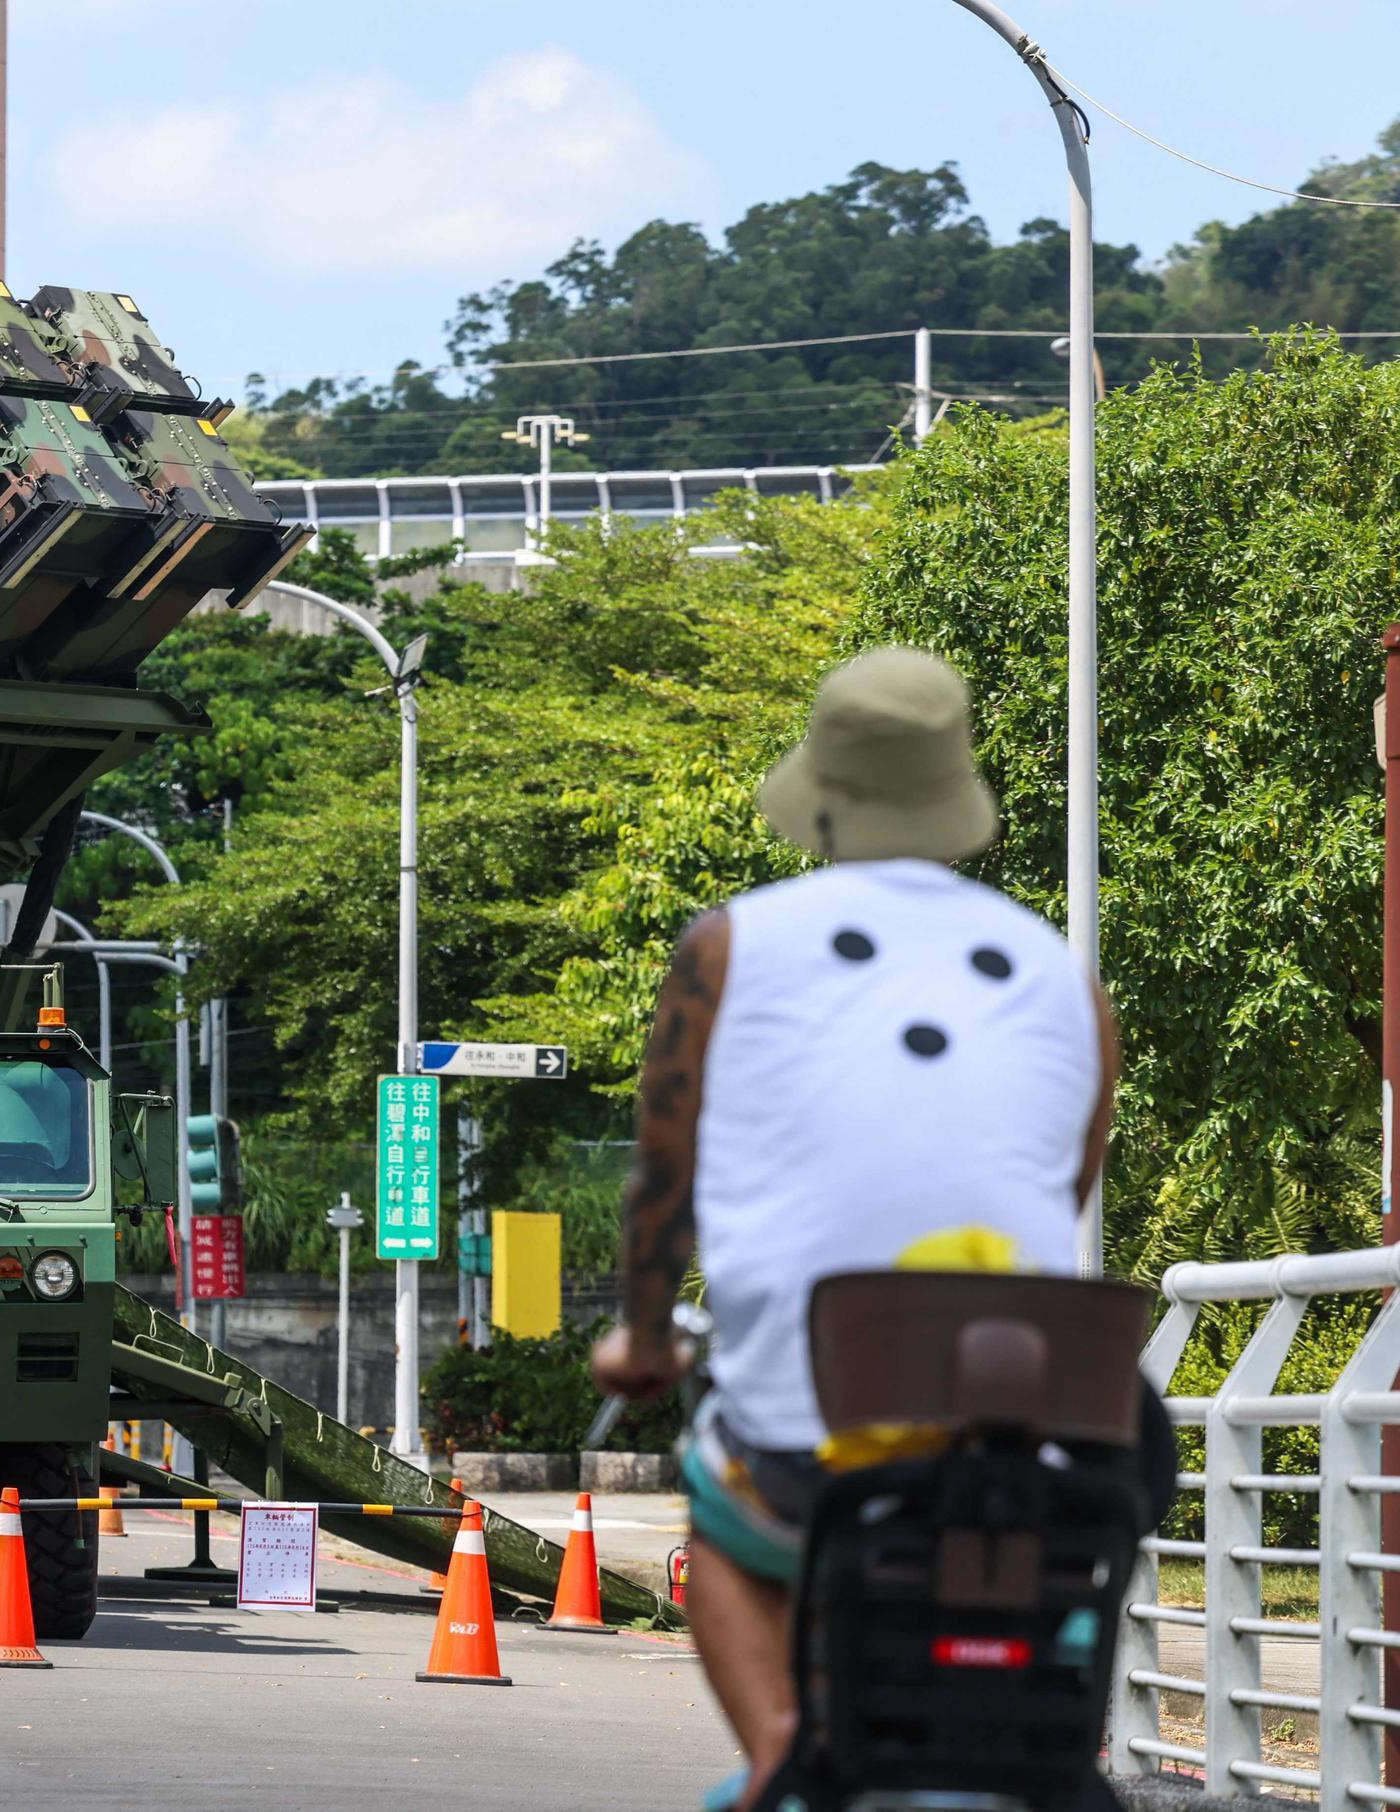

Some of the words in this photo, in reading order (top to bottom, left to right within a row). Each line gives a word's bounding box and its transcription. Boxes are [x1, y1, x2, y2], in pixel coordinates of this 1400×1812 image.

[385, 1082, 406, 1227] 往碧潭自行車道
[410, 1082, 431, 1227] 往中和自行車道
